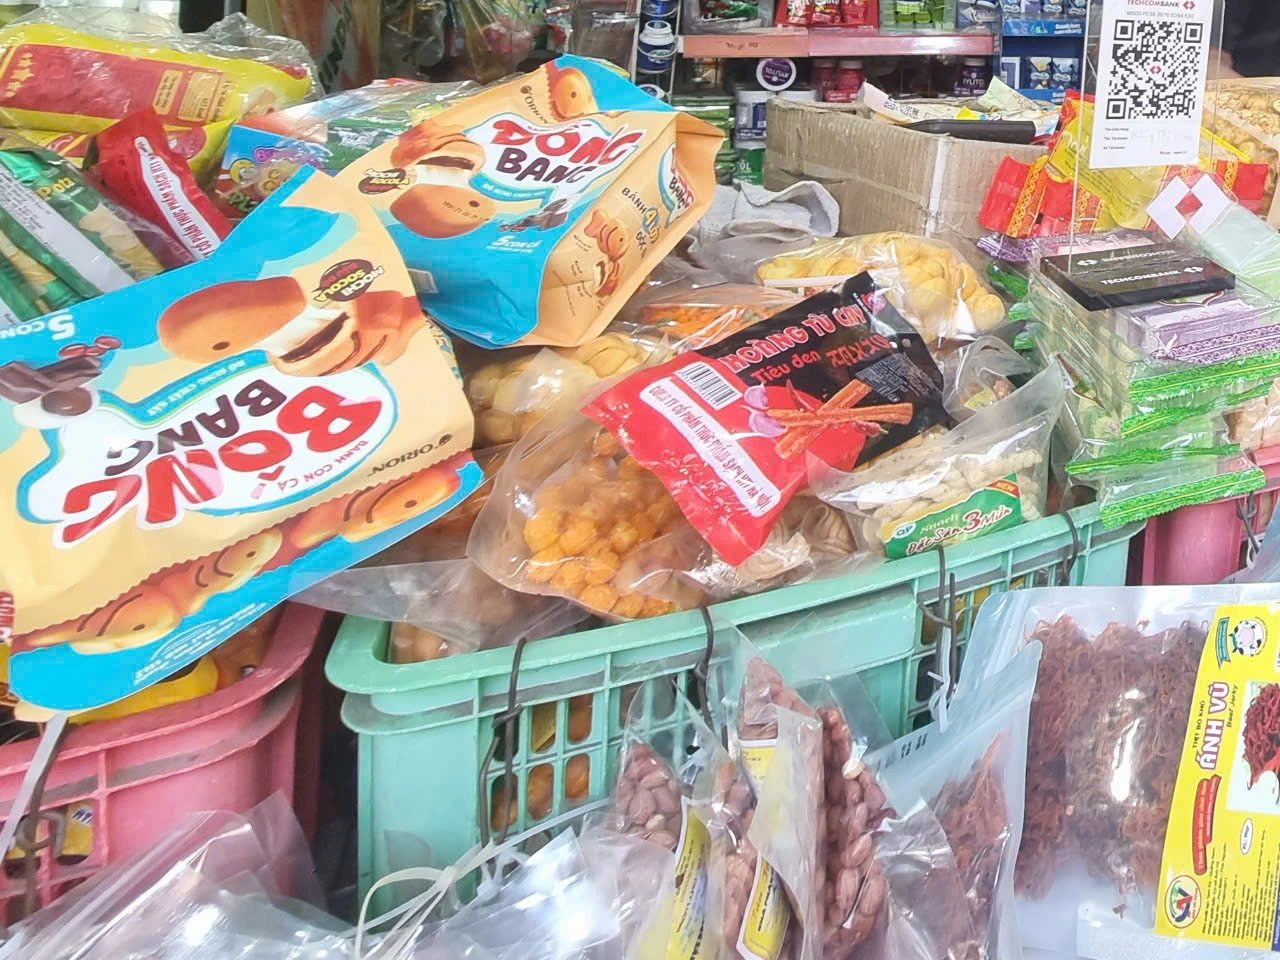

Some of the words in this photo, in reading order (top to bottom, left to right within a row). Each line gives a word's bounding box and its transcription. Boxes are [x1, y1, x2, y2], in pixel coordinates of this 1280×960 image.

[496, 147, 598, 185] BANG
[621, 186, 648, 216] BÁNH
[314, 268, 366, 303] SOCOLA
[340, 265, 385, 297] MOCHI
[1101, 269, 1181, 286] TECHCOMBANK
[47, 313, 75, 342] 5
[716, 323, 810, 374] HOÀNG
[832, 303, 868, 328] CAY
[749, 360, 790, 385] Tiêu
[790, 349, 821, 371] đen
[105, 379, 287, 476] BANG
[303, 463, 333, 482] CON
[371, 443, 434, 473] ORION
[1208, 681, 1230, 715] VŨ
[1228, 684, 1240, 706] Jerky
[1194, 718, 1225, 770] ÁNH
